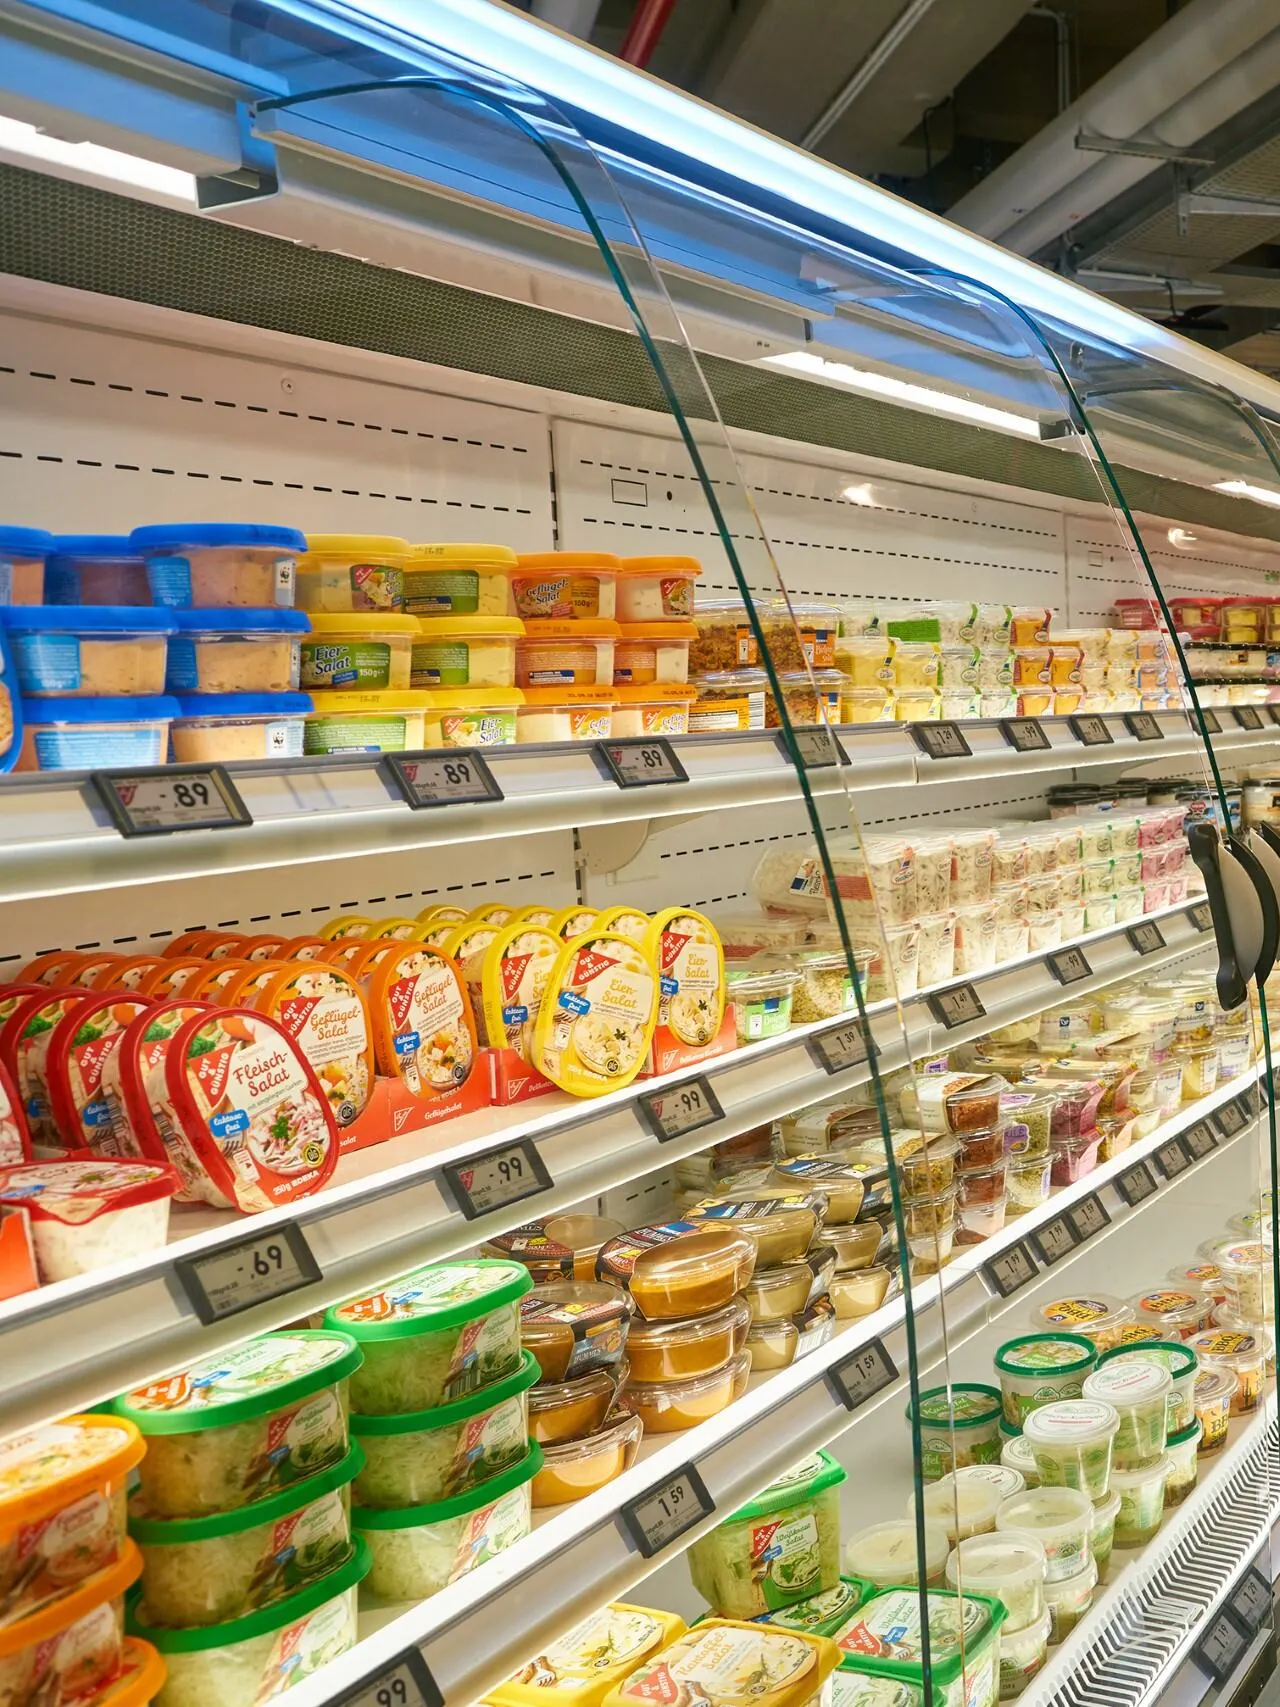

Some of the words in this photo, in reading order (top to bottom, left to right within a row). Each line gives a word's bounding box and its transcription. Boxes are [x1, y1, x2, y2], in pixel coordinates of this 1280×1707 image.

[526, 577, 569, 597] Geflügel-
[535, 590, 561, 605] Salat
[315, 645, 348, 662] Eier-
[315, 656, 351, 676] Salat
[504, 960, 514, 977] GUT
[579, 953, 596, 966] GUT
[391, 985, 403, 1003] GUT
[414, 974, 454, 1007] Geflügel-
[283, 1002, 298, 1021] GUT
[422, 994, 447, 1015] Salat
[310, 1005, 362, 1031] Geflügel-
[317, 1024, 349, 1041] Salat
[79, 1046, 95, 1068] GUT
[198, 1057, 212, 1080] GUT
[232, 1051, 289, 1086] Fleisch-
[249, 1068, 291, 1097] Salat
[856, 1354, 875, 1380] 1,59
[657, 1485, 684, 1518] 1,59
